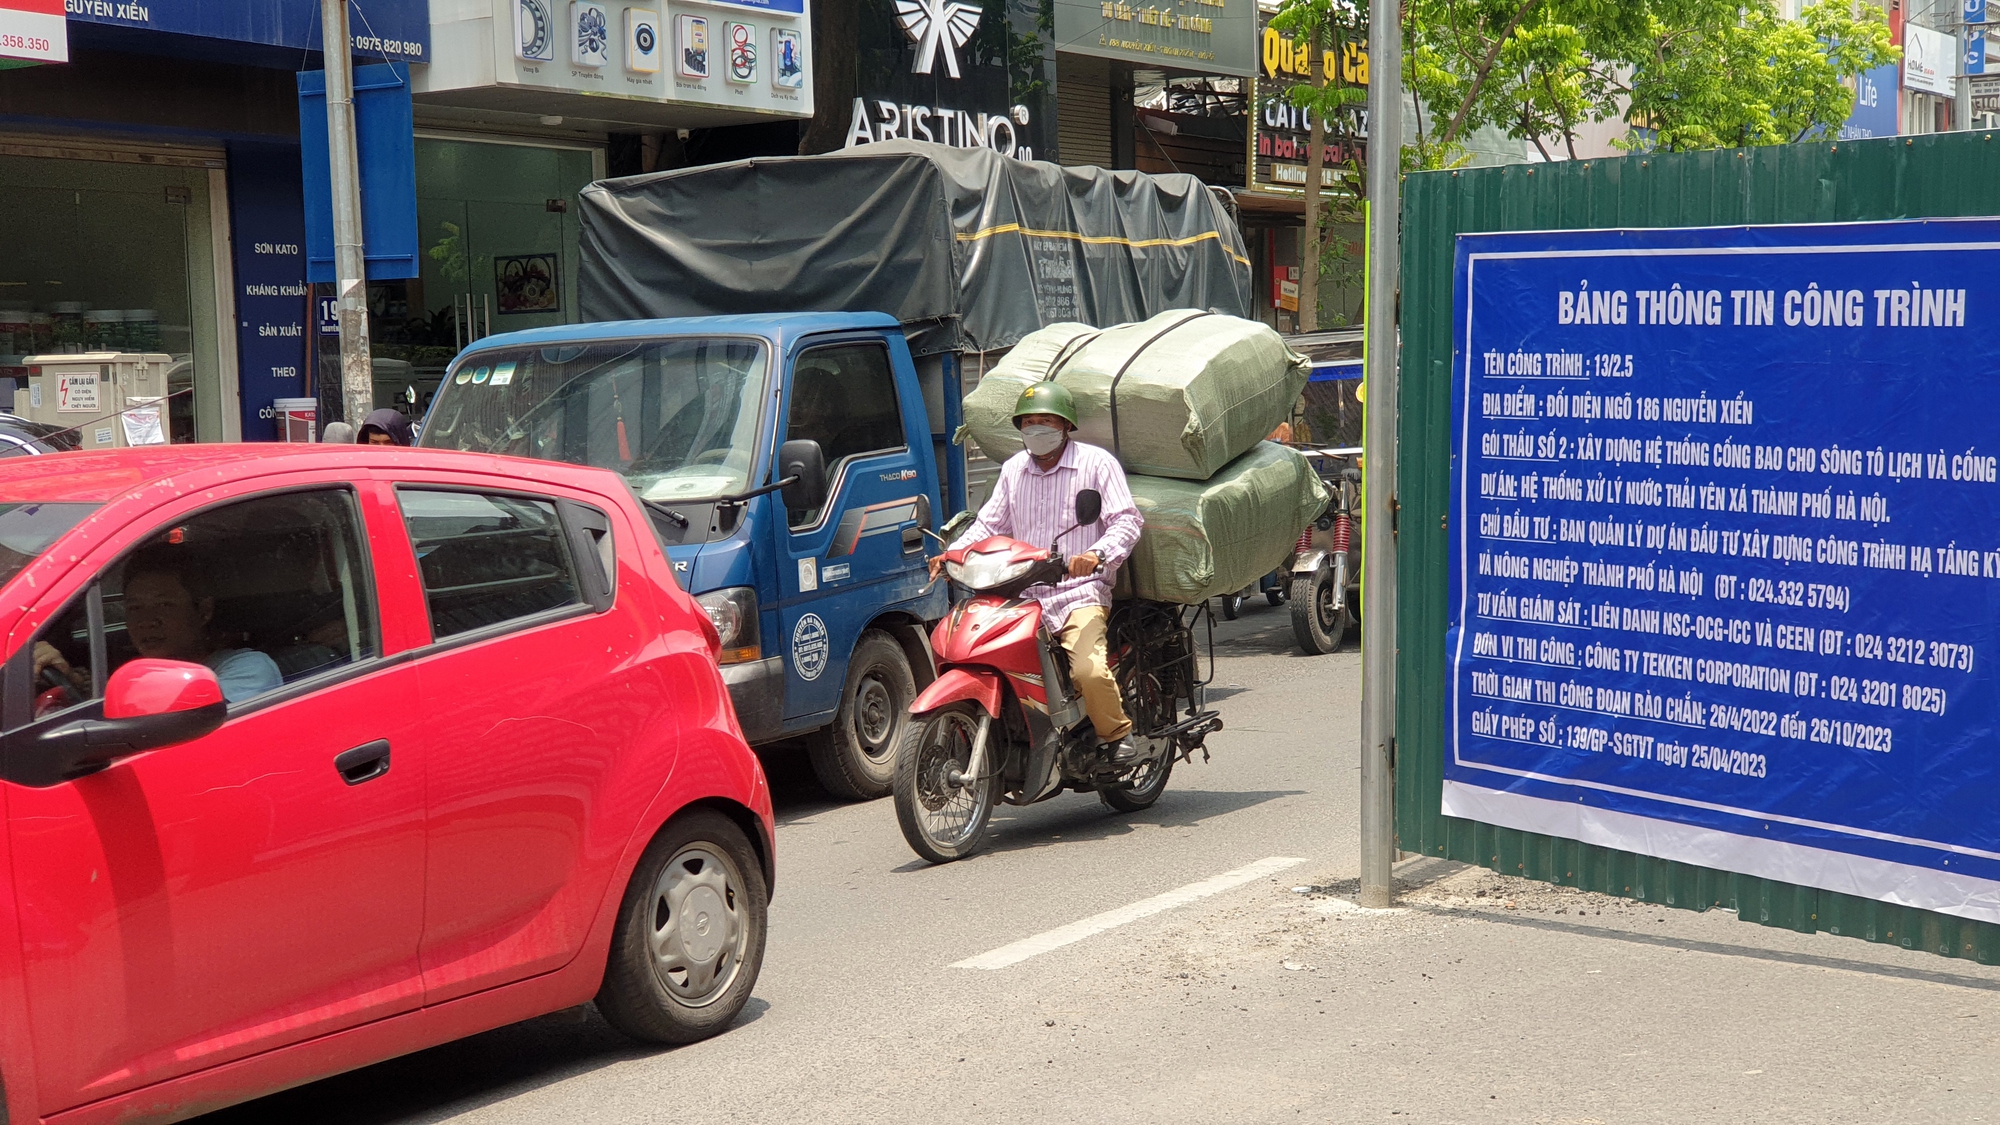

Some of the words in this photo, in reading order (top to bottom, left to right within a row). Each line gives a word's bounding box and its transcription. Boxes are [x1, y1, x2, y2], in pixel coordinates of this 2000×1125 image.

[356, 36, 381, 52] 0975
[384, 39, 402, 54] 820
[404, 42, 422, 56] 980
[1860, 76, 1878, 108] Life
[845, 97, 1016, 159] ARISTINO
[1259, 132, 1271, 156] in
[254, 242, 273, 254] SƠN
[276, 244, 298, 254] KATO
[246, 283, 278, 296] KHÁNG
[1559, 280, 1627, 326] BẢNG
[1636, 283, 1721, 326] THÔNG
[1731, 290, 1774, 326] TIN
[1784, 282, 1863, 326] CÔNG
[1874, 281, 1965, 326] TRÌNH
[258, 322, 278, 336] SẢN
[279, 322, 302, 336] XUẤT
[272, 366, 296, 378] THEO
[1484, 348, 1504, 375] TÊN
[1508, 348, 1541, 375] CÔNG
[1546, 349, 1582, 376] TRÌNH
[1595, 354, 1633, 377] 13/2.5
[258, 408, 276, 419] CÔN
[1483, 393, 1500, 419] ĐỊA
[1504, 385, 1535, 417] ĐIỂM
[1547, 387, 1568, 418] ĐỐI
[1572, 391, 1601, 423] DIỆN
[1605, 393, 1631, 419] NGÕ
[1637, 398, 1659, 421] 186
[1664, 391, 1716, 423] NGUYỄN
[1720, 391, 1752, 424] XIỂN
[1482, 429, 1499, 456] GÓI
[1503, 427, 1533, 457] THẦU
[1538, 428, 1555, 458] SỐ
[1559, 437, 1567, 459] 2
[1577, 433, 1602, 460] XÂY
[1606, 436, 1641, 466] DỰNG
[1645, 436, 1662, 468] HỆ
[1666, 434, 1709, 466] THỐNG
[1714, 436, 1750, 468] CỐNG
[1755, 446, 1782, 470] BAO
[1787, 447, 1815, 472] CHO
[1821, 444, 1862, 475] SÔNG
[1866, 446, 1883, 476] TÔ
[1888, 451, 1922, 483] LỊCH
[1927, 449, 1947, 480] VÀ
[1952, 447, 1996, 482] CỐNG
[879, 472, 900, 482] THACO
[1481, 472, 1496, 500] DỰ
[1497, 469, 1517, 497] ÁN:
[1521, 472, 1538, 503] HỆ
[1542, 469, 1582, 501] THỐNG
[1586, 472, 1605, 503] XỬ
[1607, 476, 1622, 504] LÝ
[1626, 478, 1662, 506] NƯỚC
[1666, 477, 1695, 509] THẢI
[1700, 482, 1725, 511] YÊN
[1729, 484, 1747, 513] XÁ
[1752, 486, 1797, 516] THÀNH
[1802, 486, 1831, 519] PHỐ
[1836, 491, 1856, 520] HÀ
[1860, 492, 1890, 528] NỘI.
[1480, 507, 1500, 537] CHỦ
[1503, 508, 1529, 539] ĐẦU
[1533, 516, 1550, 540] TƯ
[1560, 518, 1585, 543] BAN
[1589, 515, 1624, 546] QUẢN
[1628, 520, 1643, 548] LÝ
[1647, 522, 1666, 554] DỰ
[1668, 522, 1686, 551] ÁN
[1691, 521, 1718, 554] ĐẦU
[1722, 529, 1740, 556] TƯ
[1742, 529, 1769, 558] XÂY
[1773, 534, 1812, 565] DỰNG
[1817, 535, 1858, 566] CÔNG
[1862, 539, 1905, 570] TRÌNH
[1911, 546, 1932, 578] HẠ
[1937, 540, 1978, 576] TẦNG
[1480, 549, 1491, 576] VÀ
[1494, 551, 1529, 579] NÔNG
[1533, 556, 1578, 588] NGHIỆP
[1582, 559, 1624, 587] THÀNH
[1627, 560, 1655, 591] PHỐ
[1658, 565, 1675, 593] HÀ
[1680, 567, 1702, 600] NỘI
[1715, 574, 1737, 601] (ĐT
[1748, 578, 1804, 606] 024.332
[1808, 584, 1849, 613] 5794)
[1478, 592, 1491, 616] TƯ
[1492, 588, 1516, 618] VẤN
[1520, 590, 1554, 622] GIÁM
[1558, 597, 1581, 625] SÁT
[1592, 601, 1619, 629] LIÊN
[1623, 607, 1659, 634] DANH
[1663, 611, 1750, 645] NSC-OCG-ICC
[1755, 618, 1772, 647] VÀ
[1777, 624, 1814, 652] CEEN
[1819, 629, 1843, 656] (ĐT
[1856, 633, 1882, 660] 024
[1887, 636, 1925, 665] 3212
[1929, 641, 1973, 673] 3073)
[1473, 632, 1497, 656] ĐƠN
[1502, 635, 1513, 663] VỊ
[1517, 637, 1536, 660] THI
[1540, 636, 1574, 666] CÔNG
[1585, 641, 1620, 671] CÔNG
[1624, 649, 1639, 674] TY
[1643, 652, 1692, 681] TEKKEN
[1697, 658, 1790, 694] CORPORATION
[1794, 671, 1818, 698] (ĐT
[1831, 675, 1857, 702] 024
[1862, 679, 1896, 707] 3201
[1902, 684, 1946, 717] 8025)
[1472, 669, 1498, 696] THỜI
[1503, 675, 1532, 701] GIAN
[1535, 680, 1555, 703] THI
[1560, 679, 1593, 709] CÔNG
[1596, 688, 1631, 718] ĐOẠN
[1635, 689, 1662, 719] RÀO
[1666, 691, 1706, 726] CHẮN:
[1710, 703, 1777, 736] 26/4/2022
[1780, 711, 1806, 740] đến
[1810, 718, 1891, 753] 26/10/2023
[1472, 706, 1499, 735] GIẤY
[1502, 713, 1534, 740] PHÉP
[1539, 714, 1556, 744] SỐ
[1567, 725, 1654, 760] 139/GP-SGTVT
[1657, 740, 1688, 769] ngày
[1692, 744, 1767, 777] 25/04/2023
